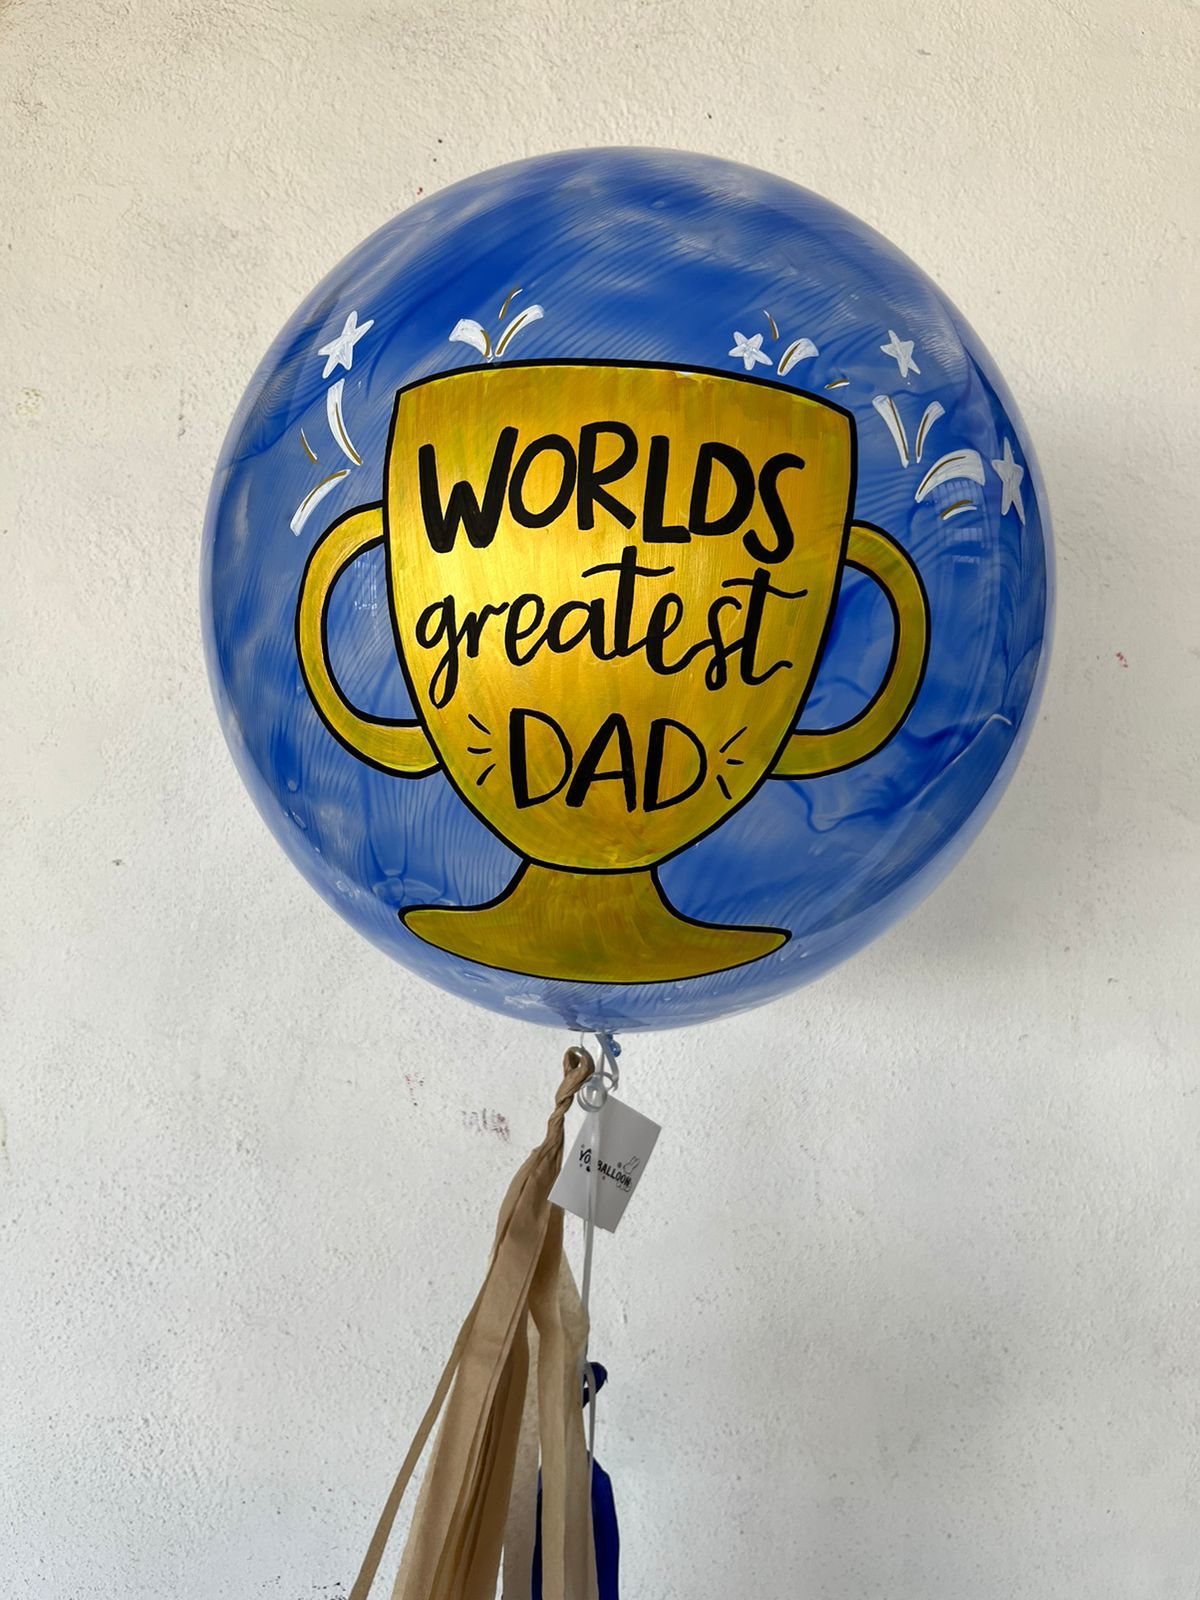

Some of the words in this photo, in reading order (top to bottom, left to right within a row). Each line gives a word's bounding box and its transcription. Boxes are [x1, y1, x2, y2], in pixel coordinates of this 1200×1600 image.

[418, 421, 805, 564] WORLDS
[415, 545, 808, 710] greatest
[508, 707, 708, 813] DAD
